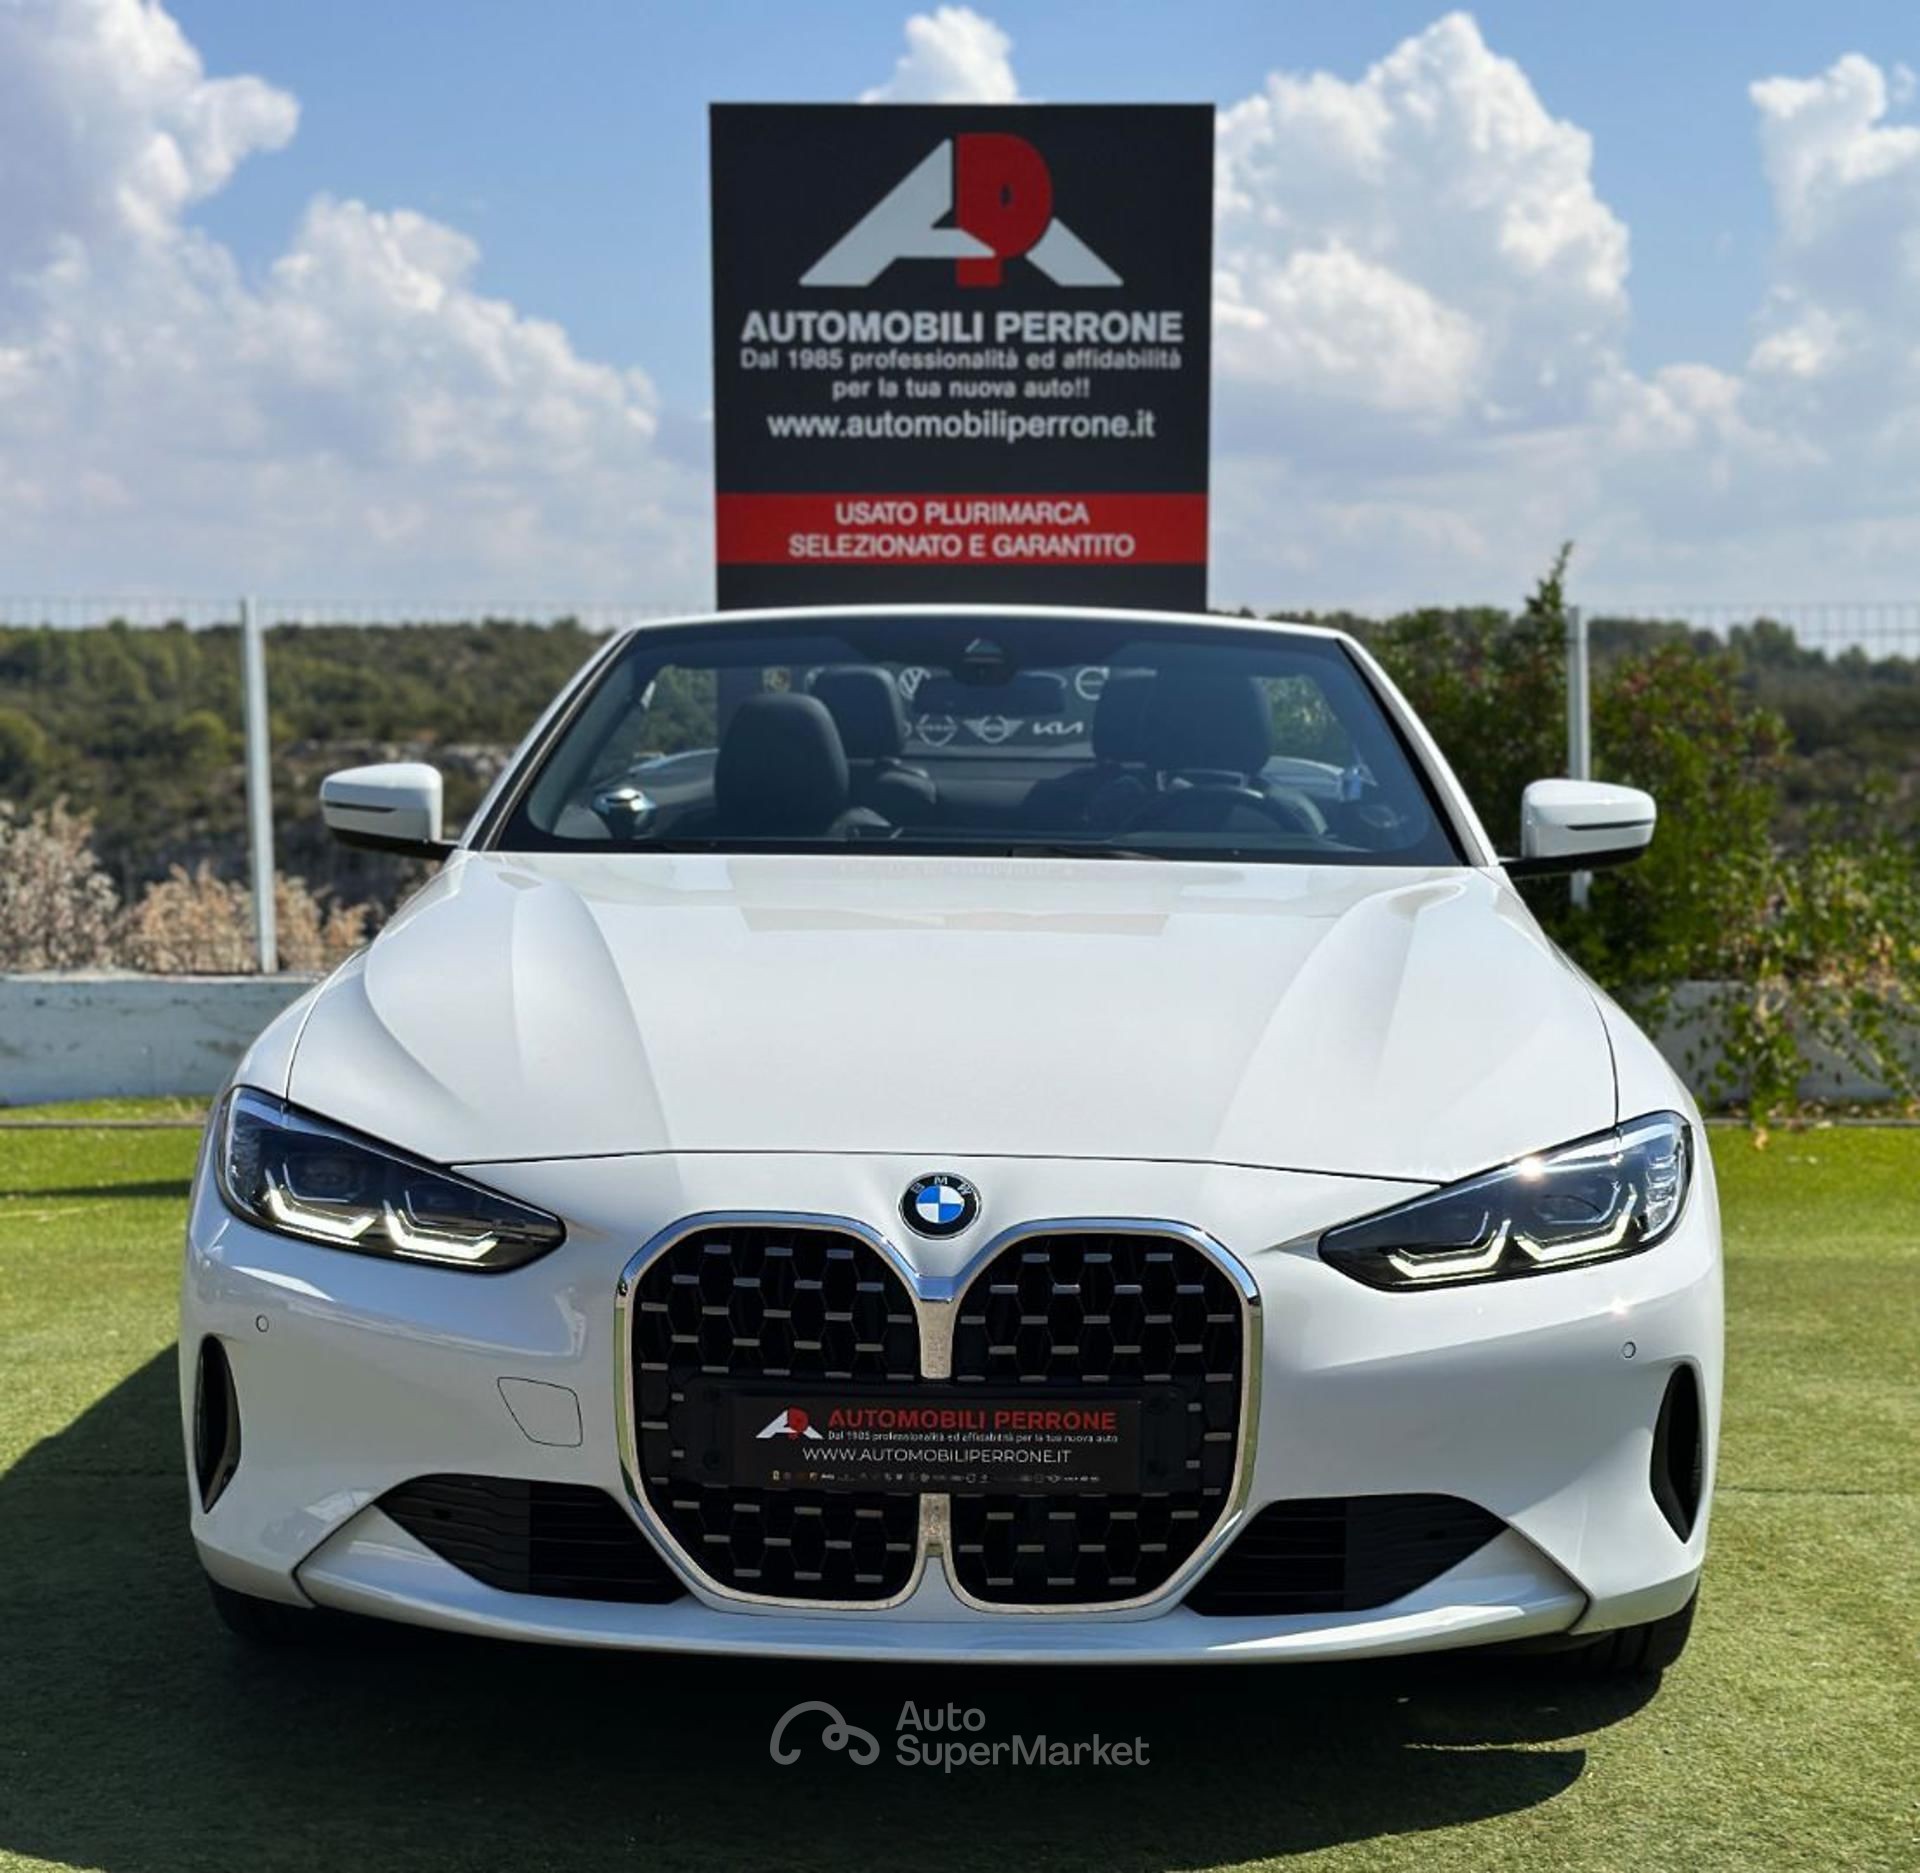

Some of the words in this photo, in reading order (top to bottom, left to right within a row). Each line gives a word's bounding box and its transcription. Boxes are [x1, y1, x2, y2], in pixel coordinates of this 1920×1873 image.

[741, 311, 983, 343] AUTOMOBILI
[995, 311, 1184, 343] PERRONE
[740, 348, 779, 370] Dal
[788, 348, 844, 370] 1985
[850, 347, 1019, 375] professionalità
[1025, 348, 1056, 370] ed
[1061, 347, 1183, 371] affidabilità
[831, 380, 871, 402] per
[878, 377, 899, 398] la
[904, 378, 942, 399] tua
[949, 380, 1017, 399] nuova
[1023, 377, 1091, 399] auto!!
[766, 409, 1156, 444] www.automobiliperrone.it
[835, 501, 917, 525] USATO
[924, 501, 1090, 525] PLURIMARCA
[788, 533, 962, 558] SELEZIONATO
[969, 534, 986, 557] E
[991, 533, 1136, 558] GARANTITO
[910, 1176, 975, 1196] BMW
[828, 1409, 986, 1429] AUTOMOBILI
[993, 1410, 1118, 1431] PERRONE
[802, 1446, 1073, 1464] WWW.AUTOMOBILIPERRONE.IT
